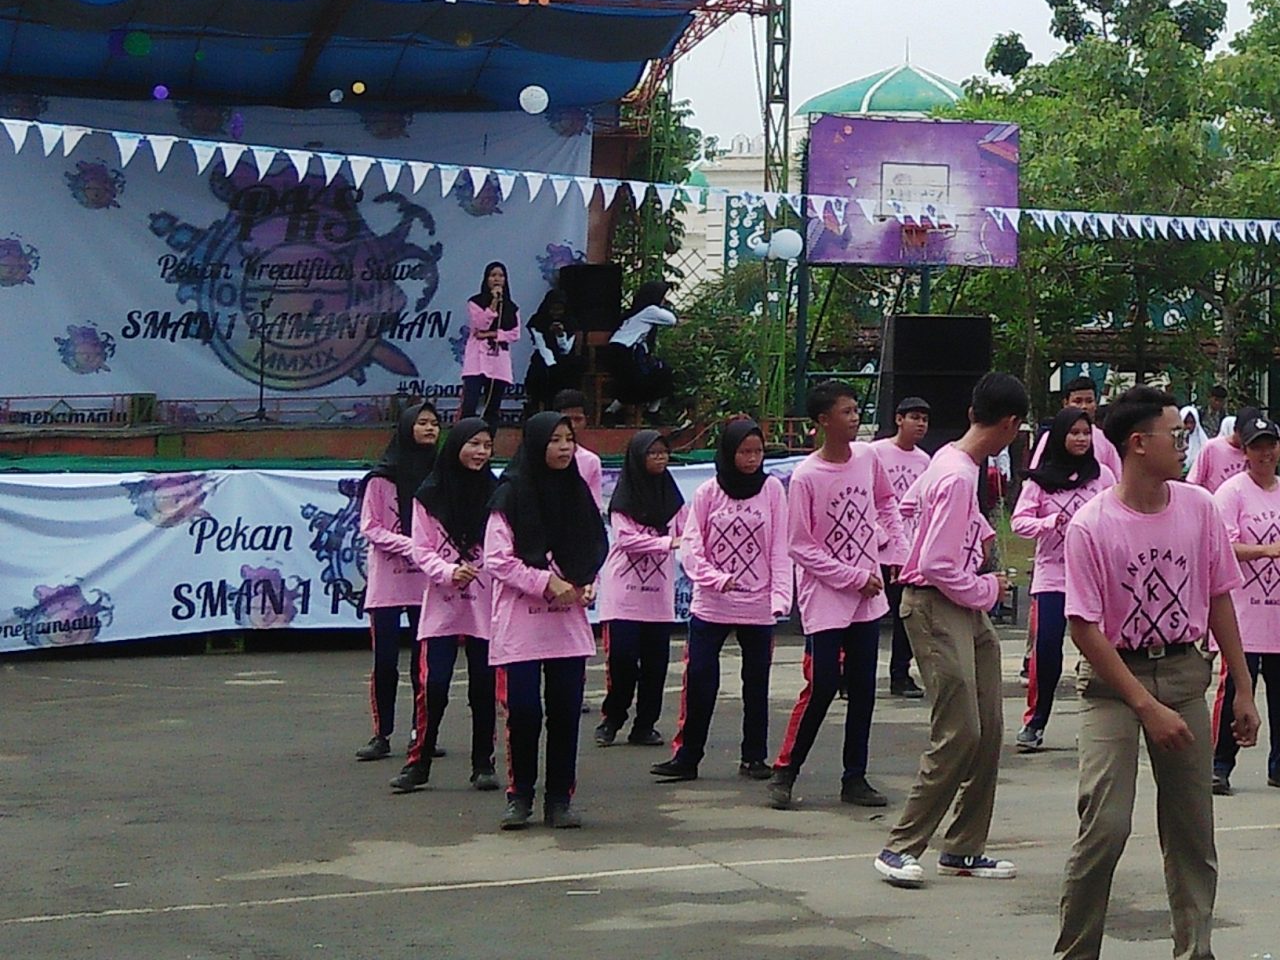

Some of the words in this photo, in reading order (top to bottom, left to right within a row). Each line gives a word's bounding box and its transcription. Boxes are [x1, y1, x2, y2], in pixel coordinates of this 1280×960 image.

[158, 253, 232, 282] Pekan
[361, 256, 426, 282] Siswa
[121, 310, 219, 344] SMAN
[223, 310, 237, 340] 1
[189, 516, 293, 554] Pekan
[1126, 548, 1188, 577] NEPAM
[171, 578, 284, 620] SMAN
[290, 579, 311, 616] 1
